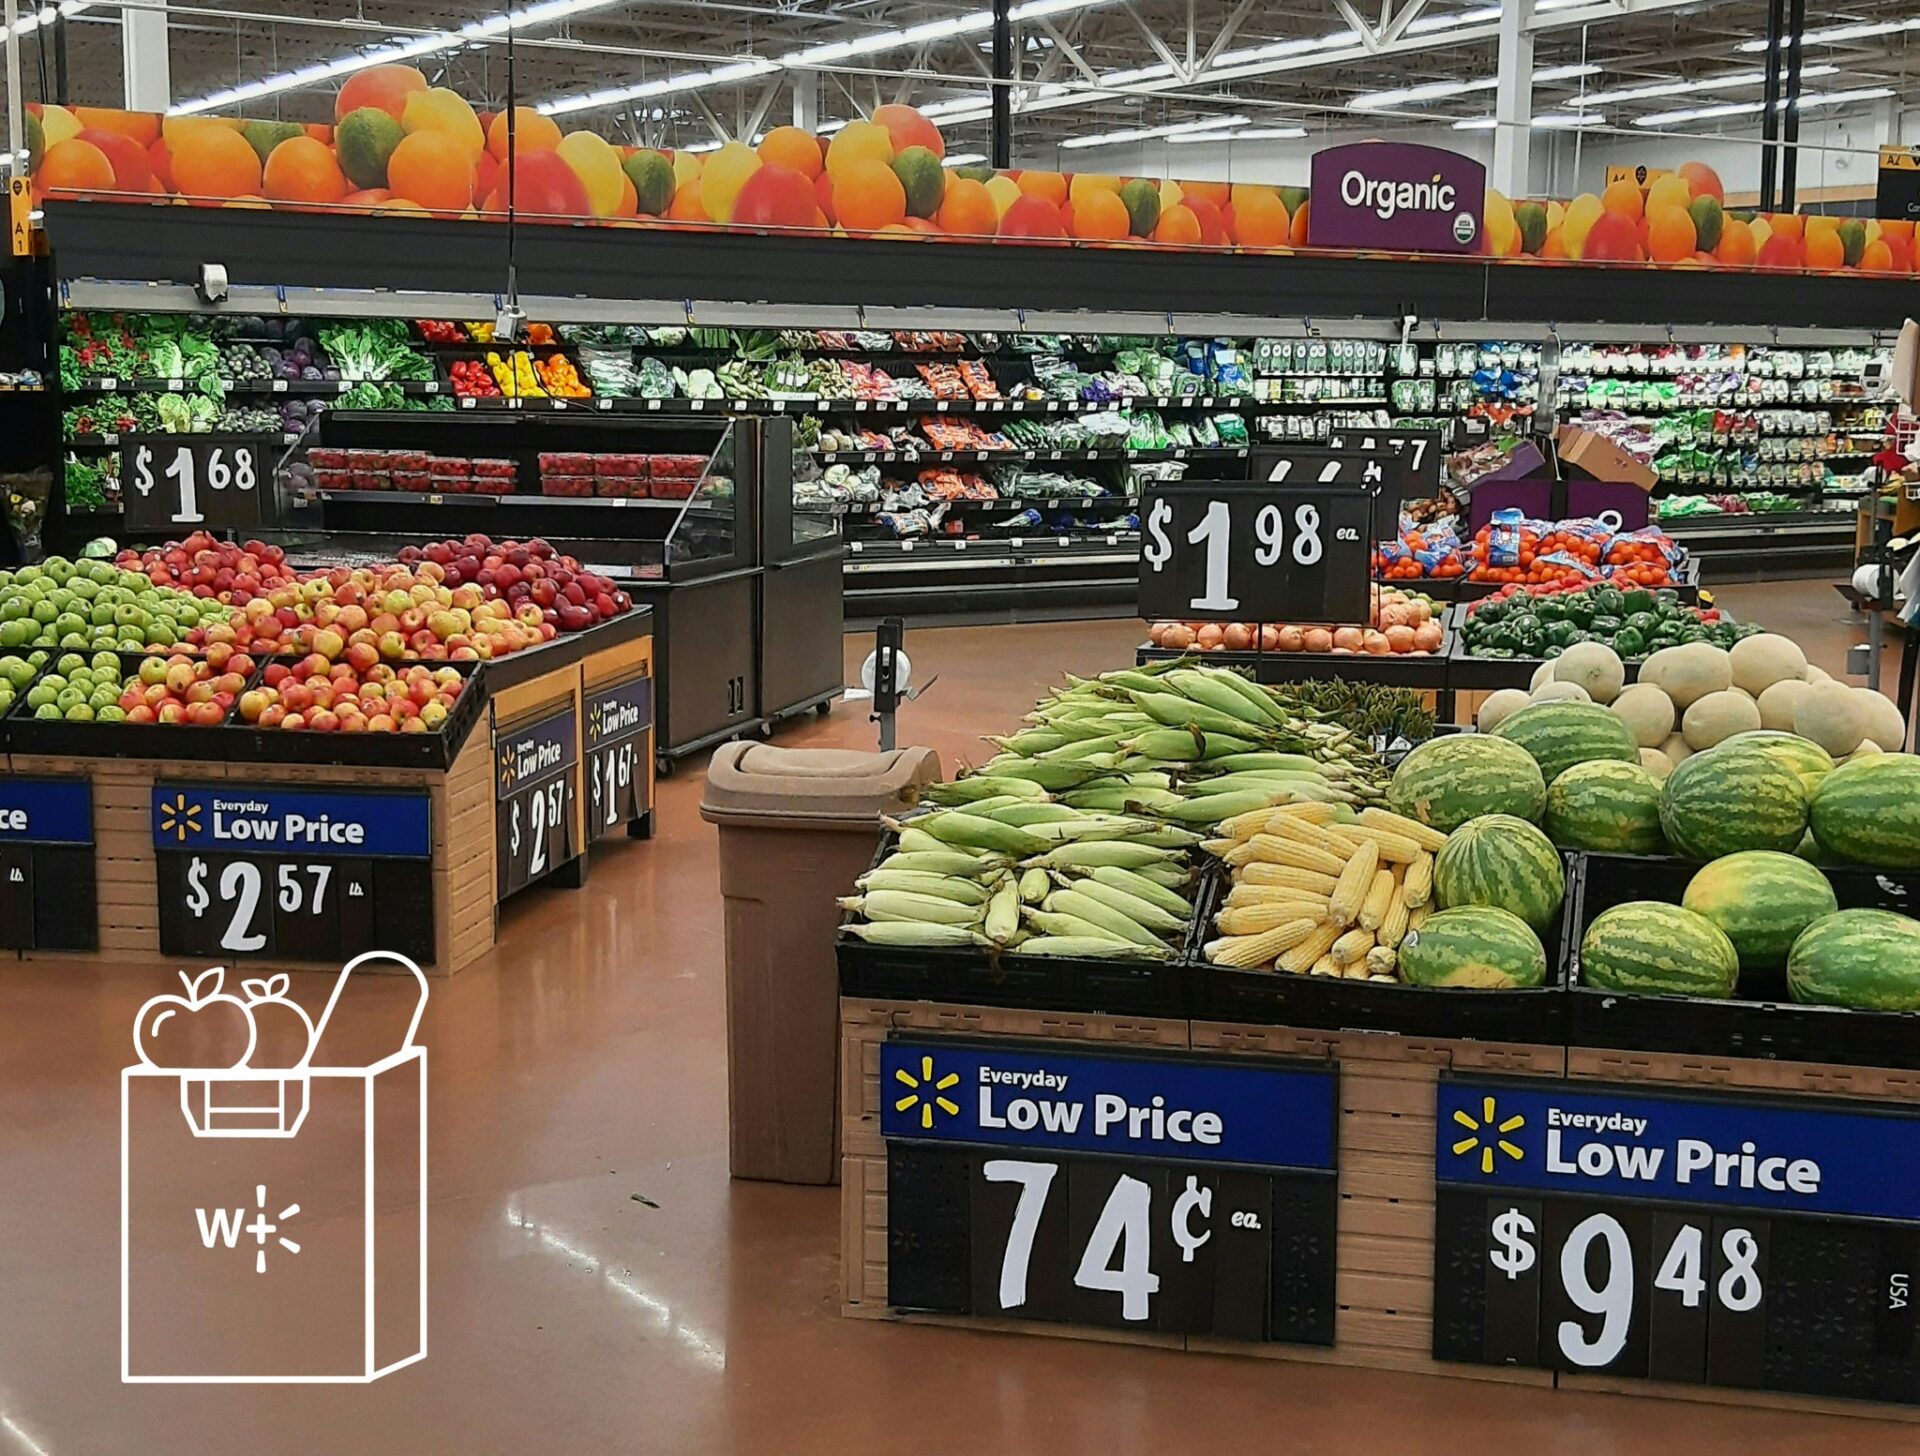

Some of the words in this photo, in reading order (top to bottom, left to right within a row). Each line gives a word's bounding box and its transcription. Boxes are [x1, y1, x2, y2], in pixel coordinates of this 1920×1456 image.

[1341, 170, 1456, 219] Organic
[1335, 526, 1360, 541] ea.
[602, 711, 619, 736] Low
[619, 702, 639, 729] Price
[517, 750, 537, 781] Low
[537, 740, 561, 771] Price
[213, 799, 269, 814] Everyday
[213, 811, 279, 841] Low
[285, 813, 365, 844] Price
[979, 1066, 1068, 1092] Everyday
[979, 1086, 1084, 1134] Low
[1094, 1094, 1224, 1145] Price
[1547, 1108, 1648, 1137] Everyday
[1546, 1128, 1665, 1180] Low
[1676, 1139, 1822, 1194] Price
[1230, 1209, 1262, 1230] ea.
[1888, 1273, 1909, 1310] USA
